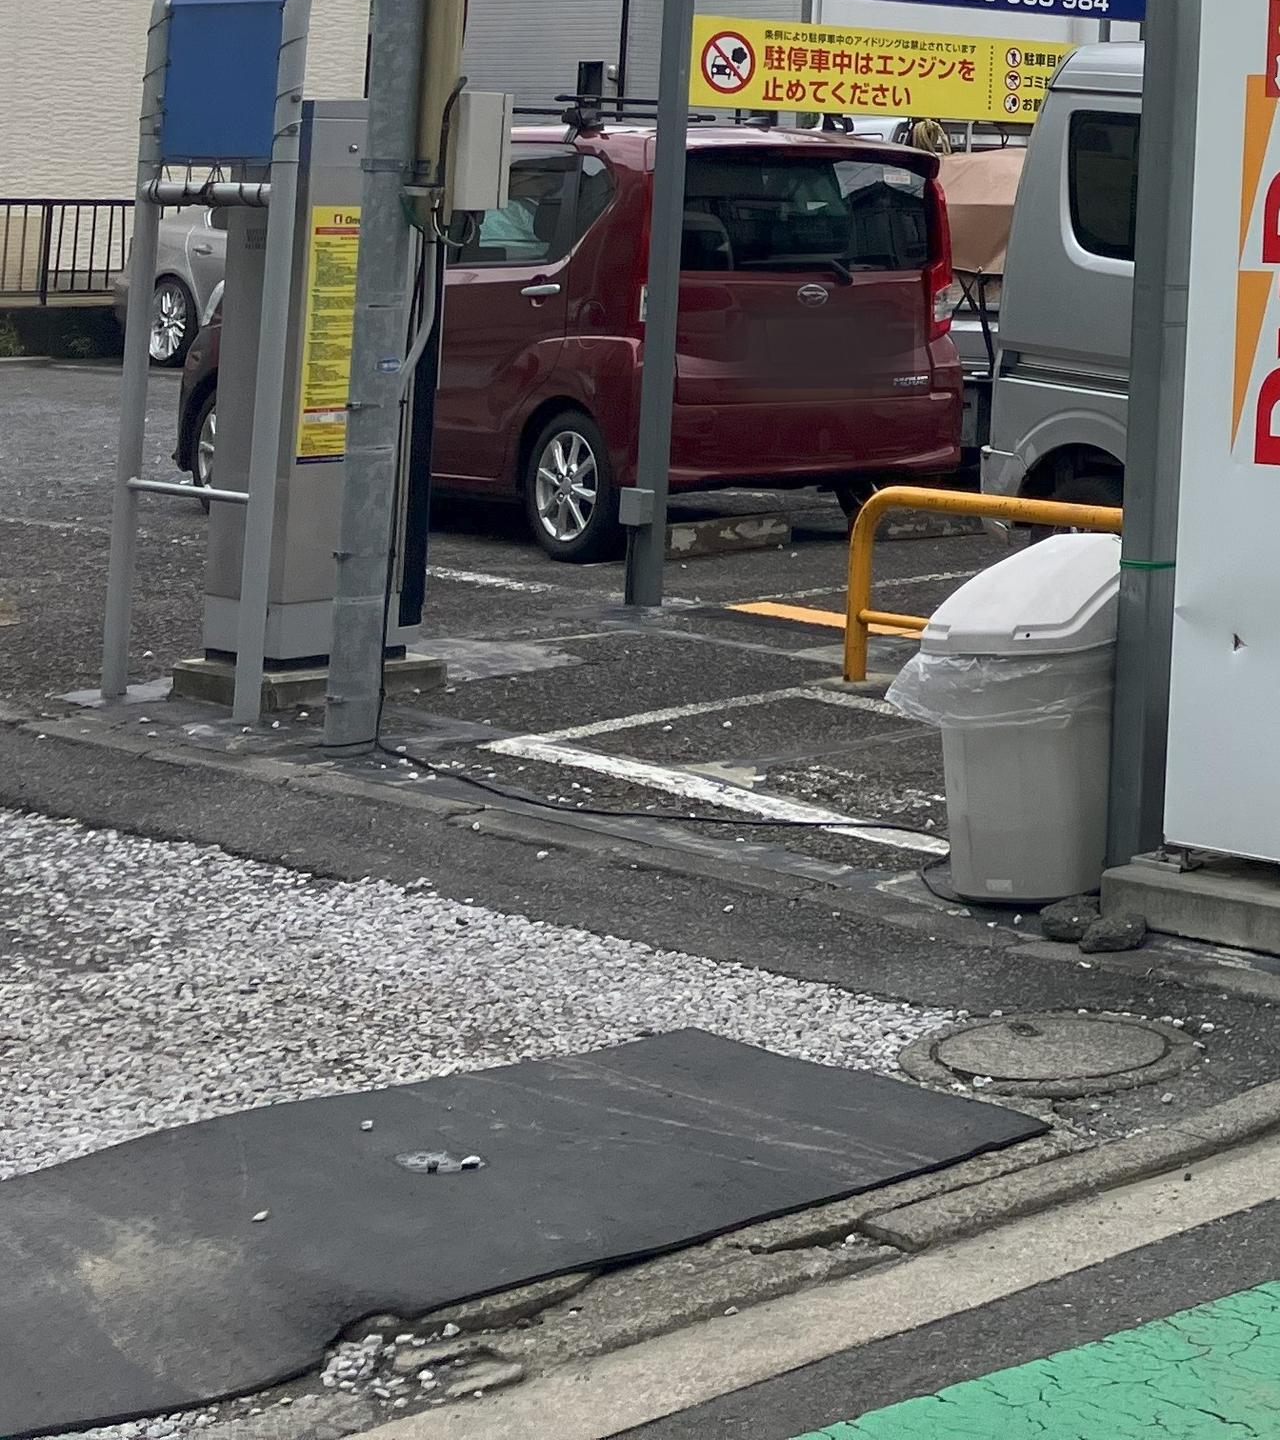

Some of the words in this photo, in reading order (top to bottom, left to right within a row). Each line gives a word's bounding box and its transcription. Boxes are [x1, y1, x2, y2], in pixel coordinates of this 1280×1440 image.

[763, 45, 976, 83] 駐停車中はエンジンを
[762, 76, 912, 107] 止めてください
